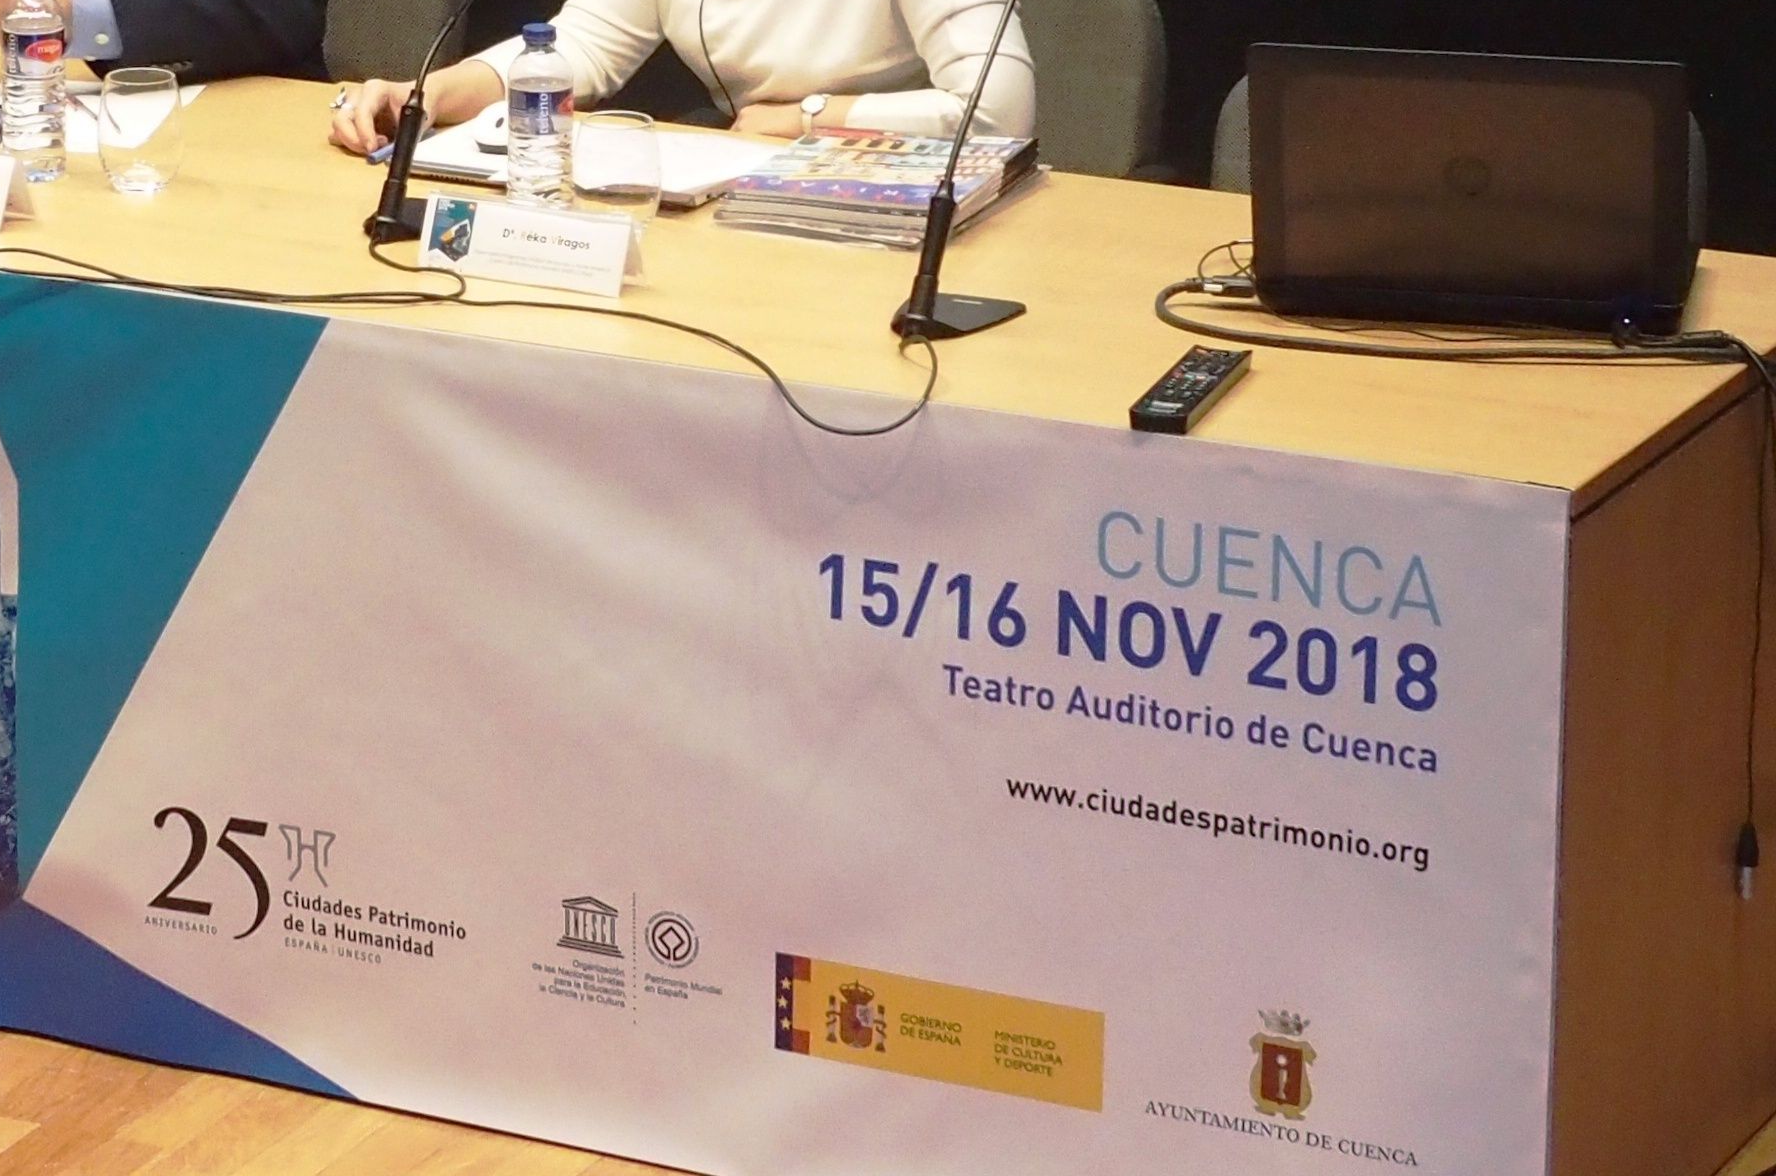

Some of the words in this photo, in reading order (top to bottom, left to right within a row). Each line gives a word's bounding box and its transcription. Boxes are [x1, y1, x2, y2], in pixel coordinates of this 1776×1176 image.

[1095, 510, 1442, 627] CUENCA
[818, 552, 1026, 649] 15/16
[1057, 589, 1222, 677] NOV
[1246, 620, 1439, 713] 2018
[942, 664, 1055, 712] Teatro
[1065, 684, 1234, 741] Auditorio
[1246, 714, 1290, 749] de
[1302, 723, 1438, 774] Cuenca
[1006, 778, 1430, 872] www.ciudadespatrimonio.org
[147, 806, 270, 940] 25
[144, 915, 218, 936] ANIVERSARIO
[282, 890, 362, 920] Ciudades
[368, 906, 467, 941] Patrimonio
[283, 915, 304, 933] de
[311, 918, 328, 937] la
[334, 922, 435, 958] Humanidad
[900, 1012, 962, 1034] GOBIERNO
[900, 1026, 916, 1038] DE
[994, 1030, 1056, 1051] MINISTERIO
[994, 1042, 1009, 1054] DE
[1011, 1044, 1063, 1066] CULTURA
[994, 1055, 1001, 1066] Y
[1004, 1058, 1053, 1077] DEPORTE
[1145, 1099, 1300, 1144] AYUNTAMIENTO
[1305, 1131, 1332, 1151] DE
[1337, 1138, 1418, 1166] CUENCA
